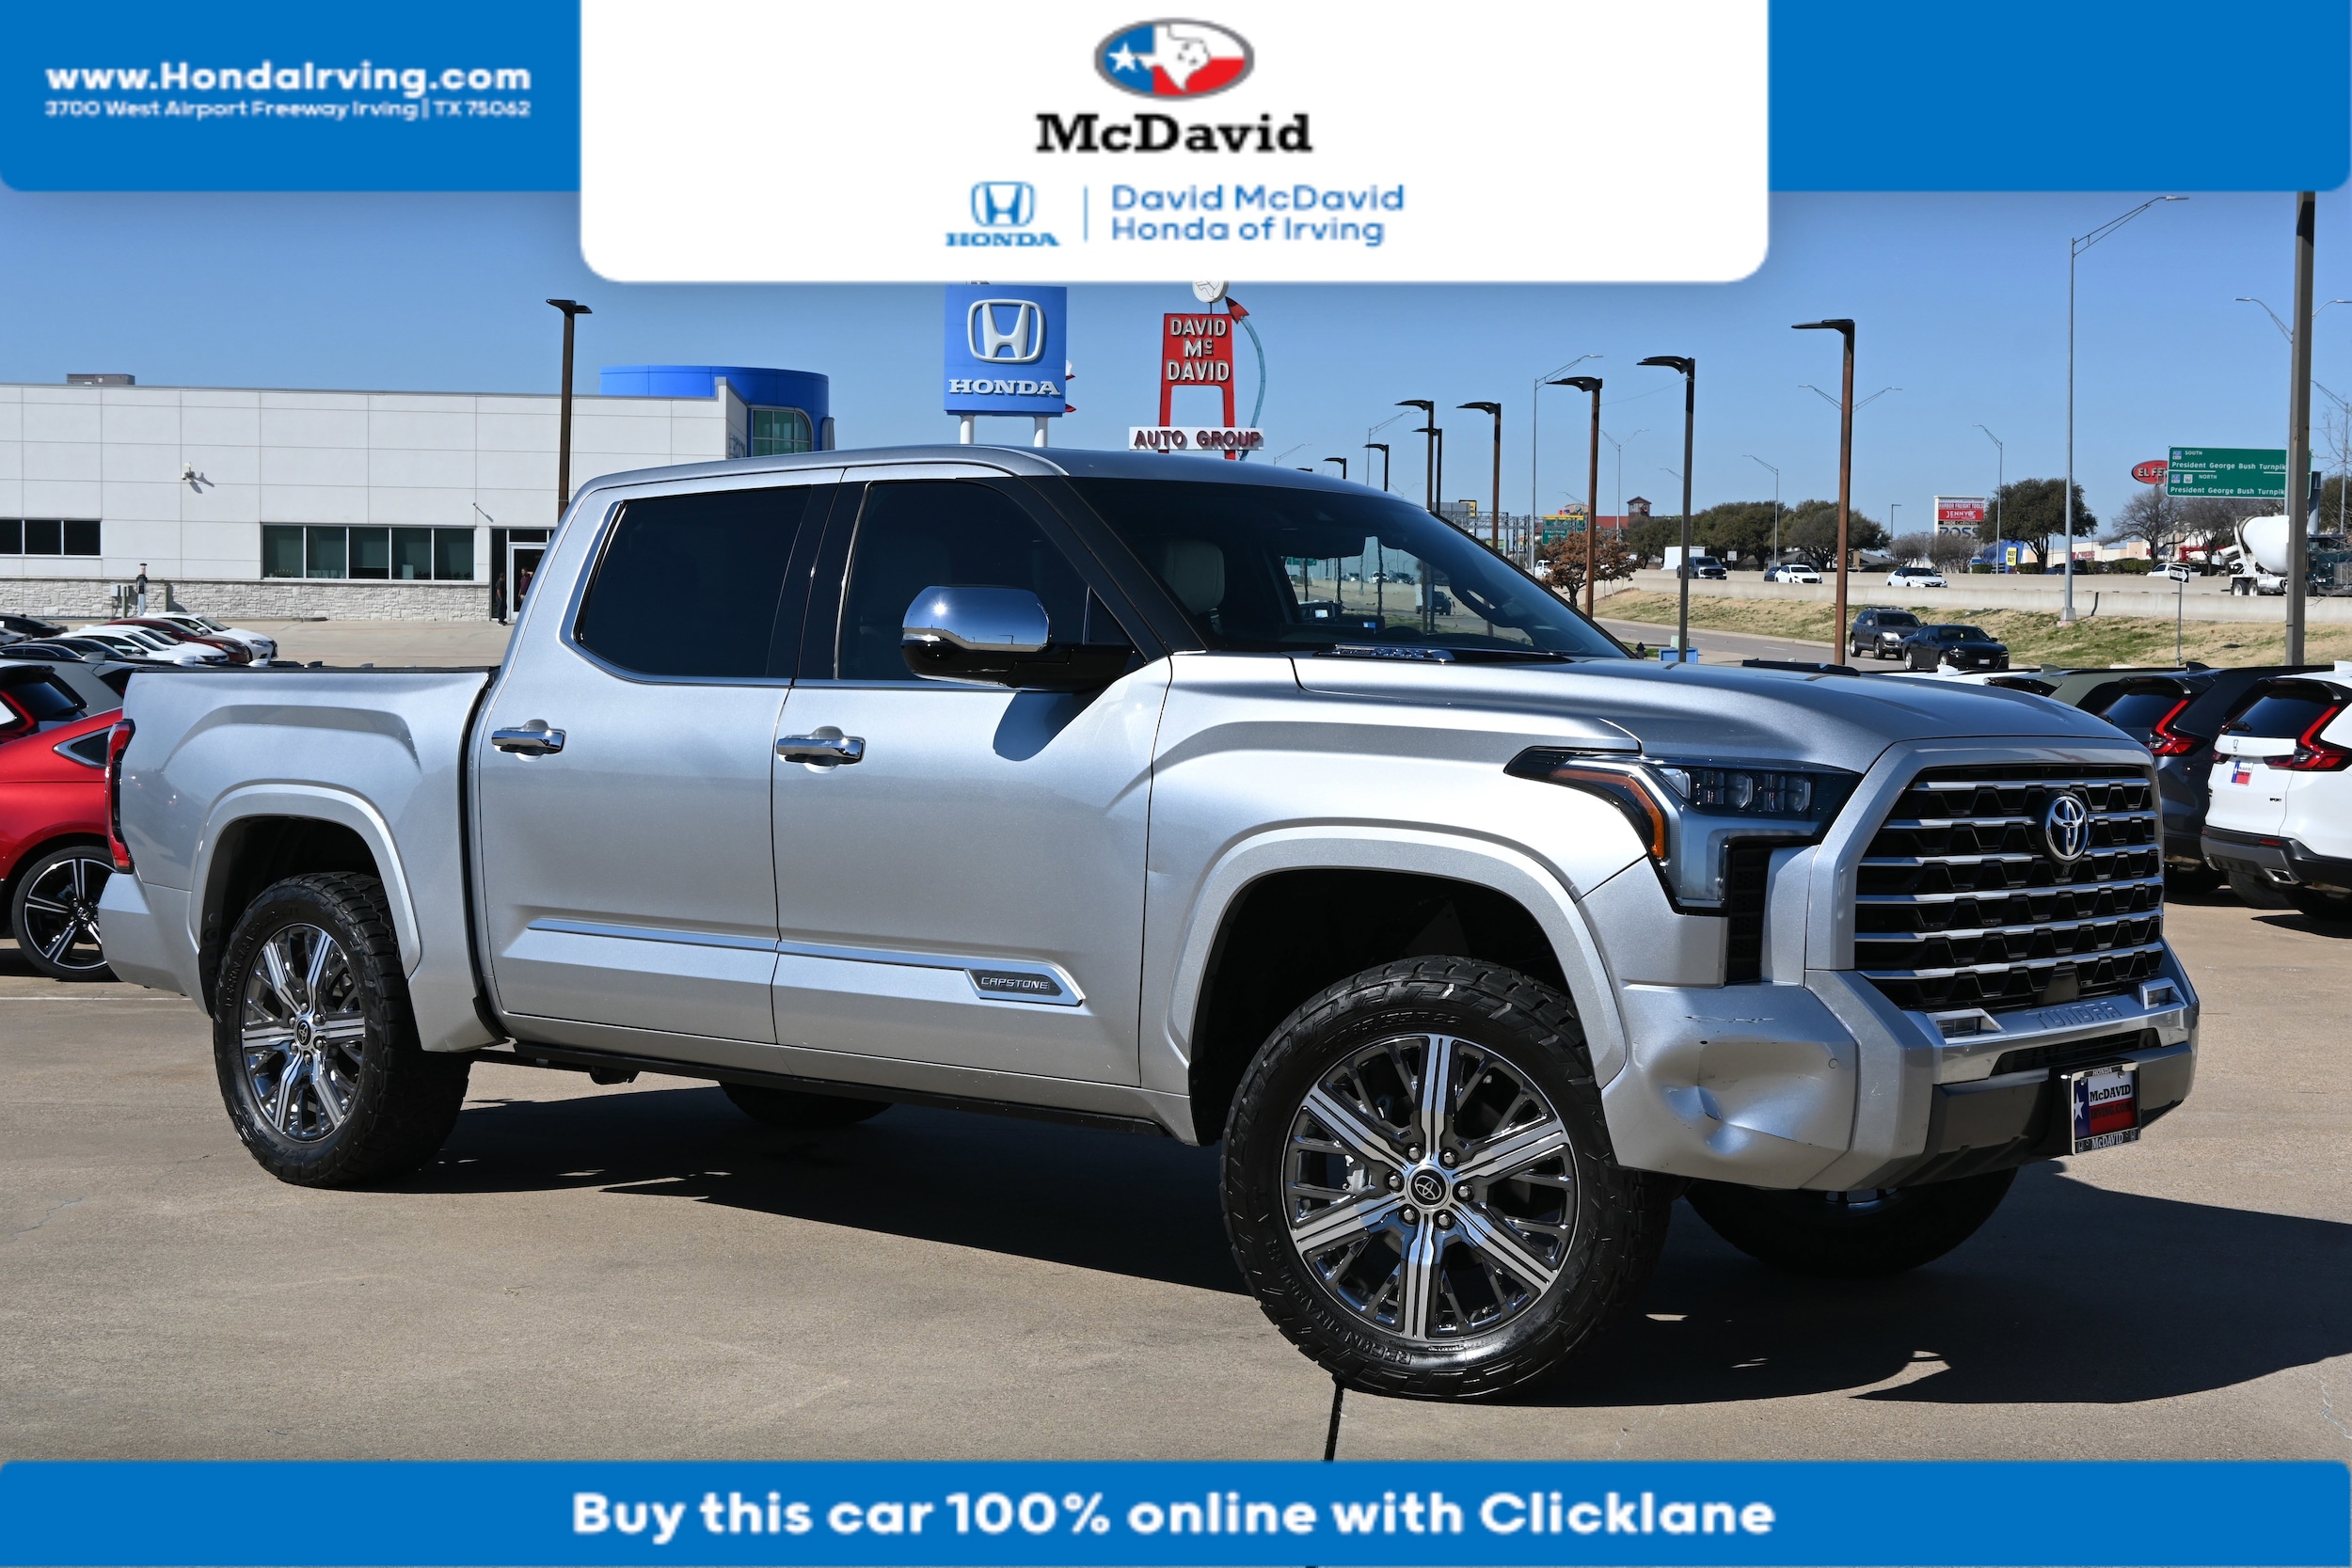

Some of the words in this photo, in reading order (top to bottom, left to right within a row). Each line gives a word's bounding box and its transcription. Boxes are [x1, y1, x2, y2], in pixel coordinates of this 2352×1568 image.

[1170, 318, 1227, 337] DAVID
[1167, 360, 1230, 381] DAVID
[948, 378, 1061, 397] HONDA
[1134, 430, 1186, 448] AUTO
[1196, 431, 1261, 448] GROUP
[2138, 467, 2150, 477] EL
[2259, 463, 2287, 471] Turnpik
[980, 976, 1050, 990] CAPSTONE
[2025, 1002, 2122, 1029] TUNDRA
[2092, 1067, 2113, 1076] HONDA
[2090, 1085, 2132, 1102] McDAVID
[2091, 1132, 2124, 1150] McDAVID
